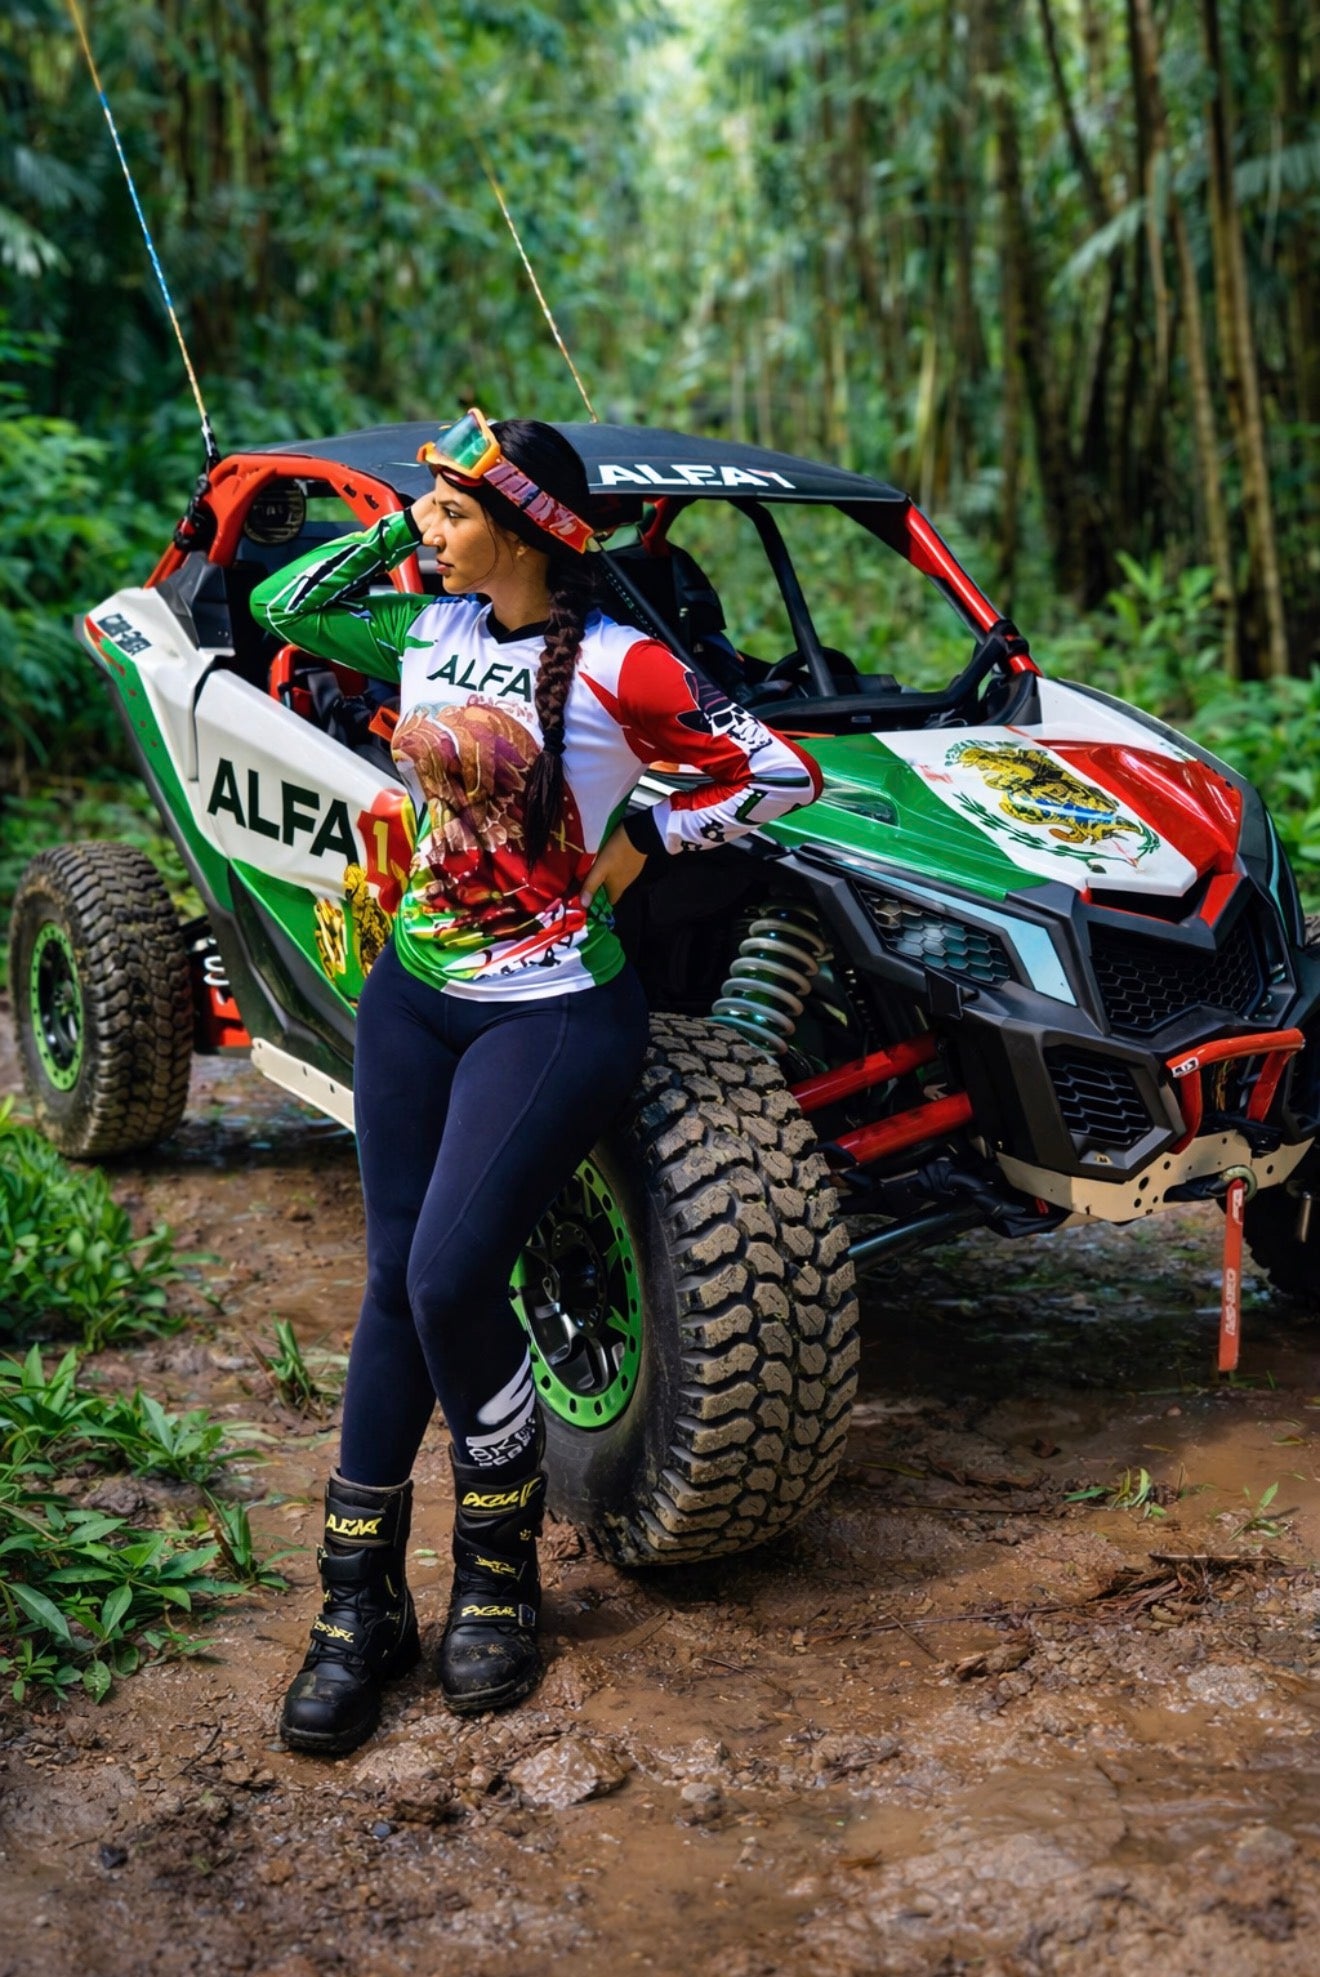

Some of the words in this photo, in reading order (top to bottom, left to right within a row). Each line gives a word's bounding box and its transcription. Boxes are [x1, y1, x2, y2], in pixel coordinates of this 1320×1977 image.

[426, 654, 532, 703] ALFA
[207, 757, 360, 868] ALFA
[373, 820, 389, 876] 1
